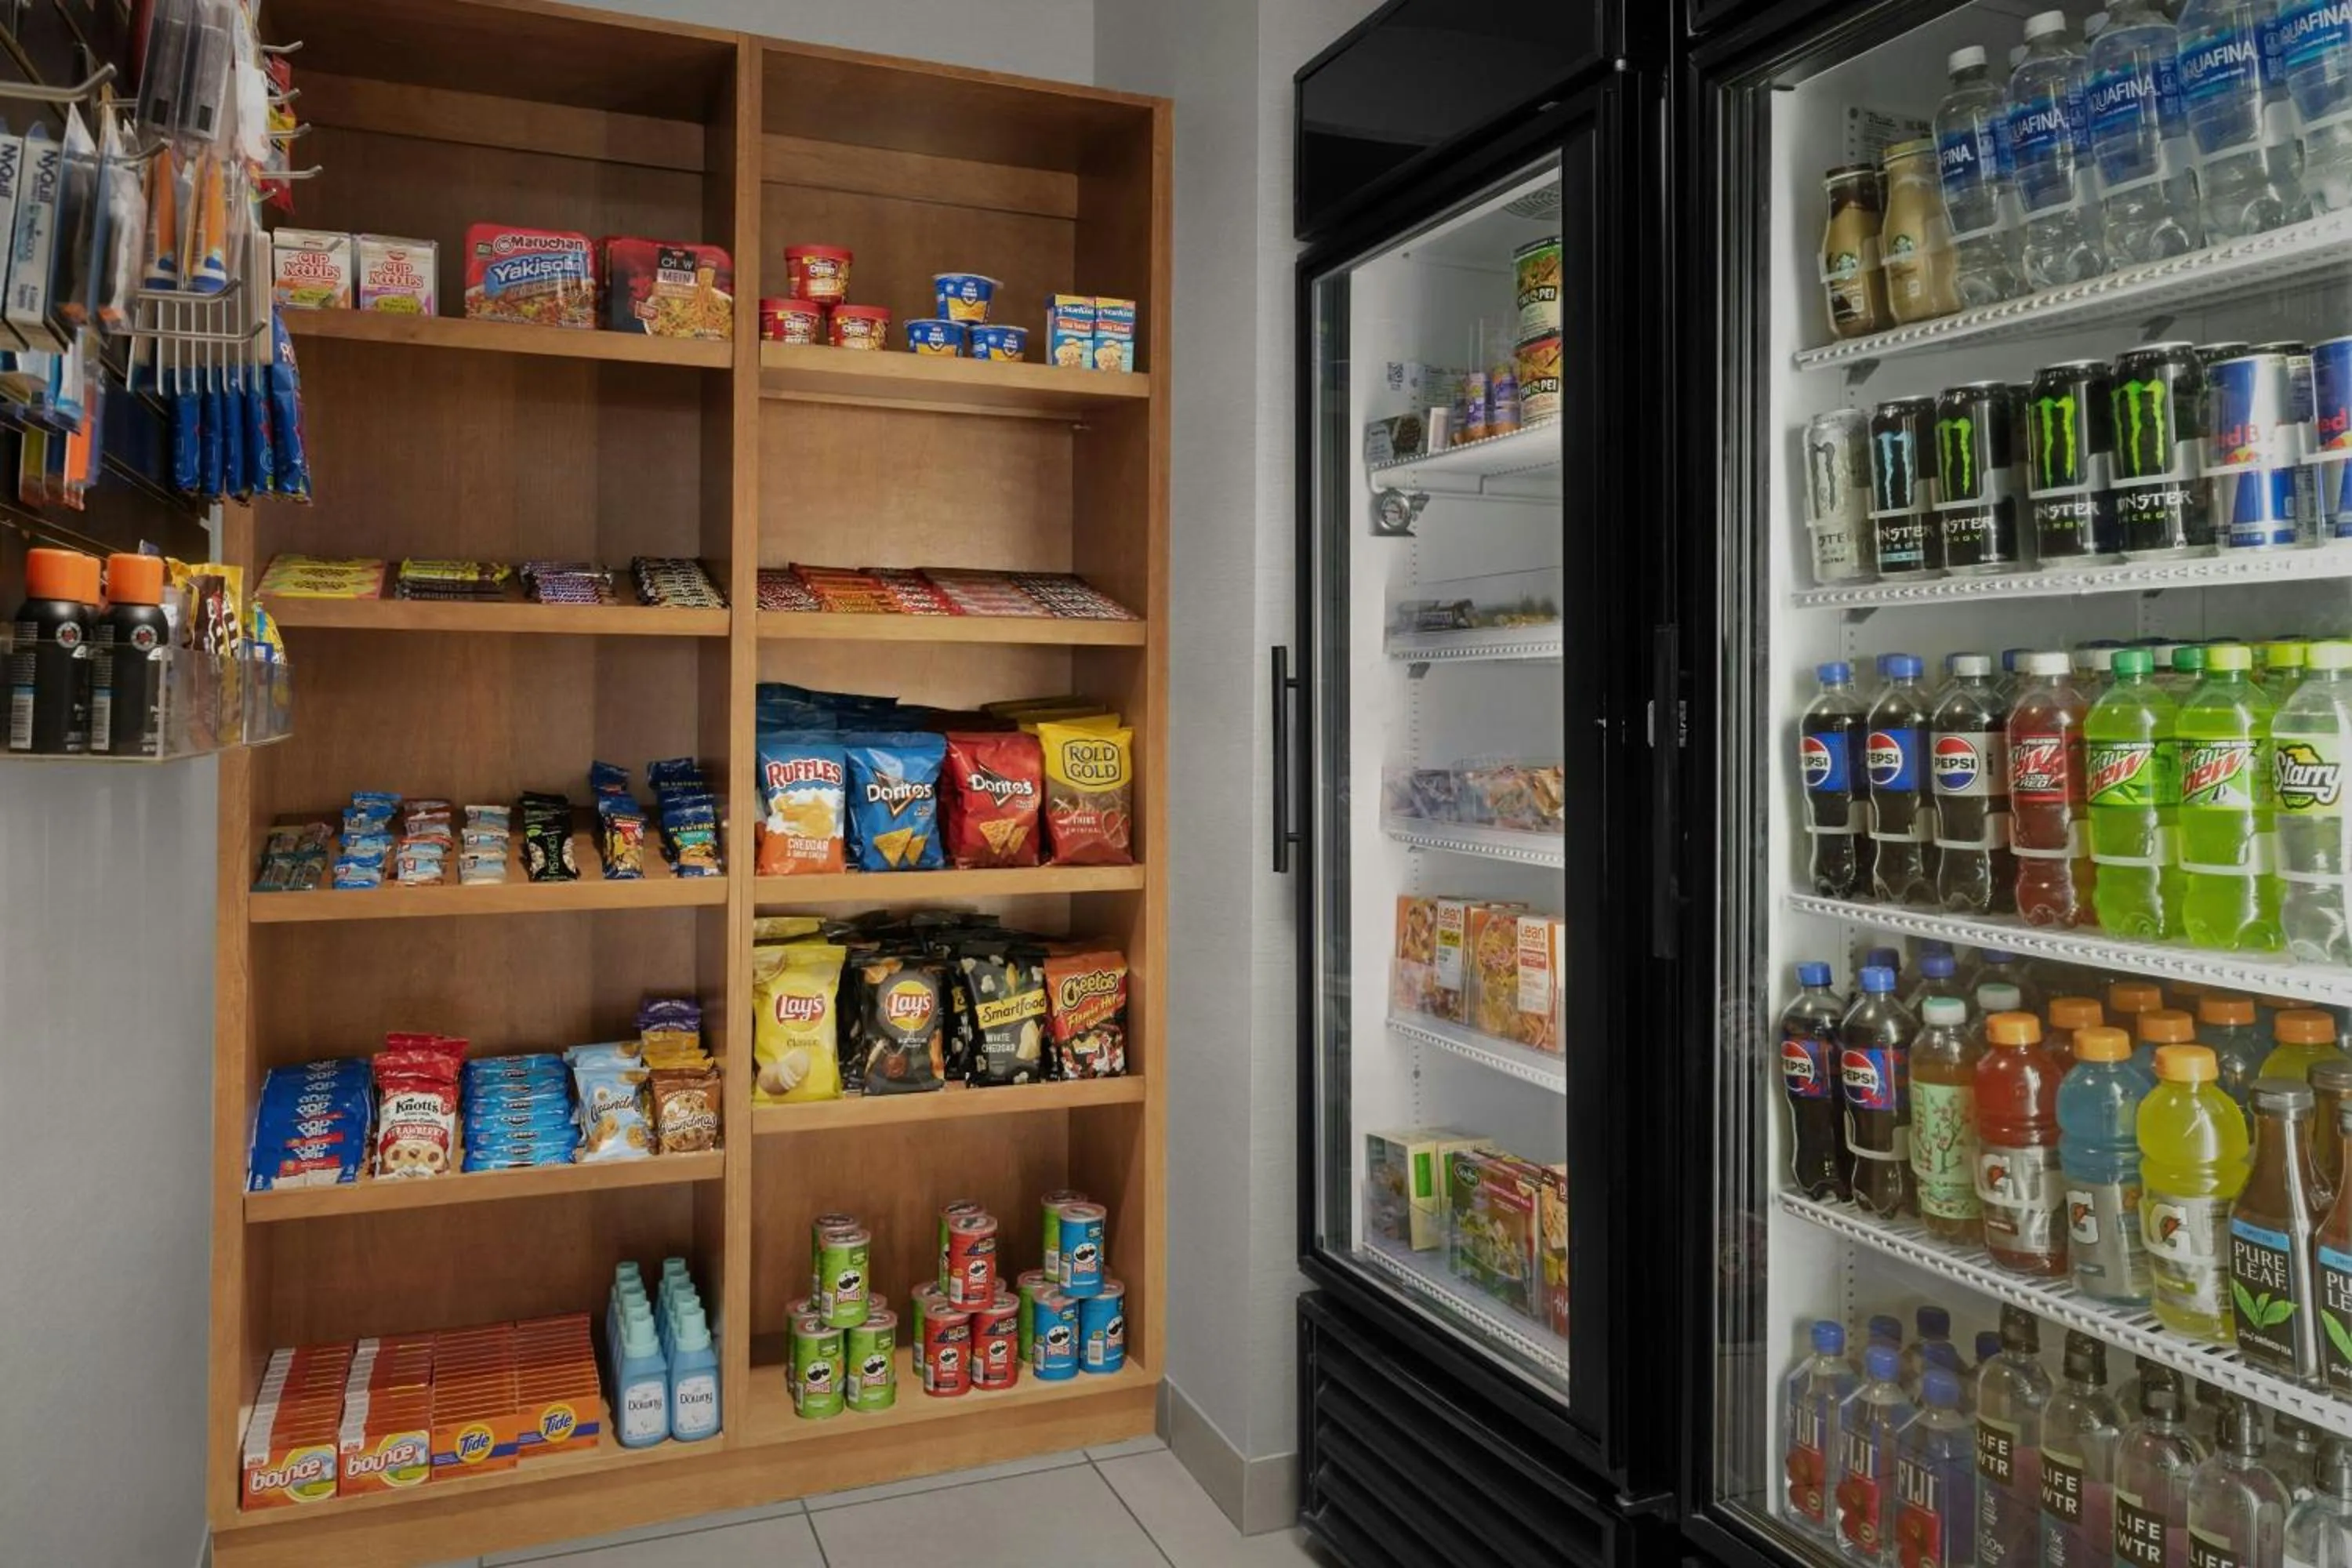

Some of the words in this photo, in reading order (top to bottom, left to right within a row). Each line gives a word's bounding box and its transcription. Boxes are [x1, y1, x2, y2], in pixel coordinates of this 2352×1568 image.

[2281, 2, 2352, 43] QUAFINA
[2092, 74, 2160, 111] QUAFINA
[511, 236, 583, 250] Maruchan
[298, 251, 330, 265] CUP
[383, 262, 413, 274] CUP
[661, 257, 694, 270] CHW
[284, 261, 340, 280] NOODLES
[368, 271, 424, 288] NOODLES
[1069, 746, 1116, 764] ROLD
[1935, 757, 1975, 770] PEPSI
[768, 758, 843, 789] RUFFLES
[1070, 764, 1117, 779] GOLD
[2275, 751, 2341, 804] Starry
[866, 783, 933, 802] Doritos
[970, 773, 1034, 795] Doritos
[1519, 924, 1546, 939] Lean
[1062, 971, 1117, 1008] Cheetos
[779, 995, 823, 1021] Lay's
[891, 993, 931, 1019] Lay's
[982, 996, 1046, 1023] Smartfood
[982, 1043, 1016, 1054] CHEDDAR
[395, 1098, 439, 1114] Knott's
[2235, 1241, 2286, 1272] PURE
[2236, 1258, 2283, 1288] LEAF
[2326, 1270, 2352, 1294] PU
[2327, 1290, 2352, 1312] LE
[543, 1414, 573, 1436] Tide
[1790, 1404, 1820, 1450] IJI
[459, 1433, 490, 1457] Tide
[347, 1443, 415, 1477] bounce
[249, 1458, 321, 1493] bounce
[1897, 1458, 1934, 1511] FIJI
[2041, 1464, 2078, 1494] LIFE
[2118, 1511, 2161, 1541] LIFE
[2118, 1533, 2162, 1563] WTR
